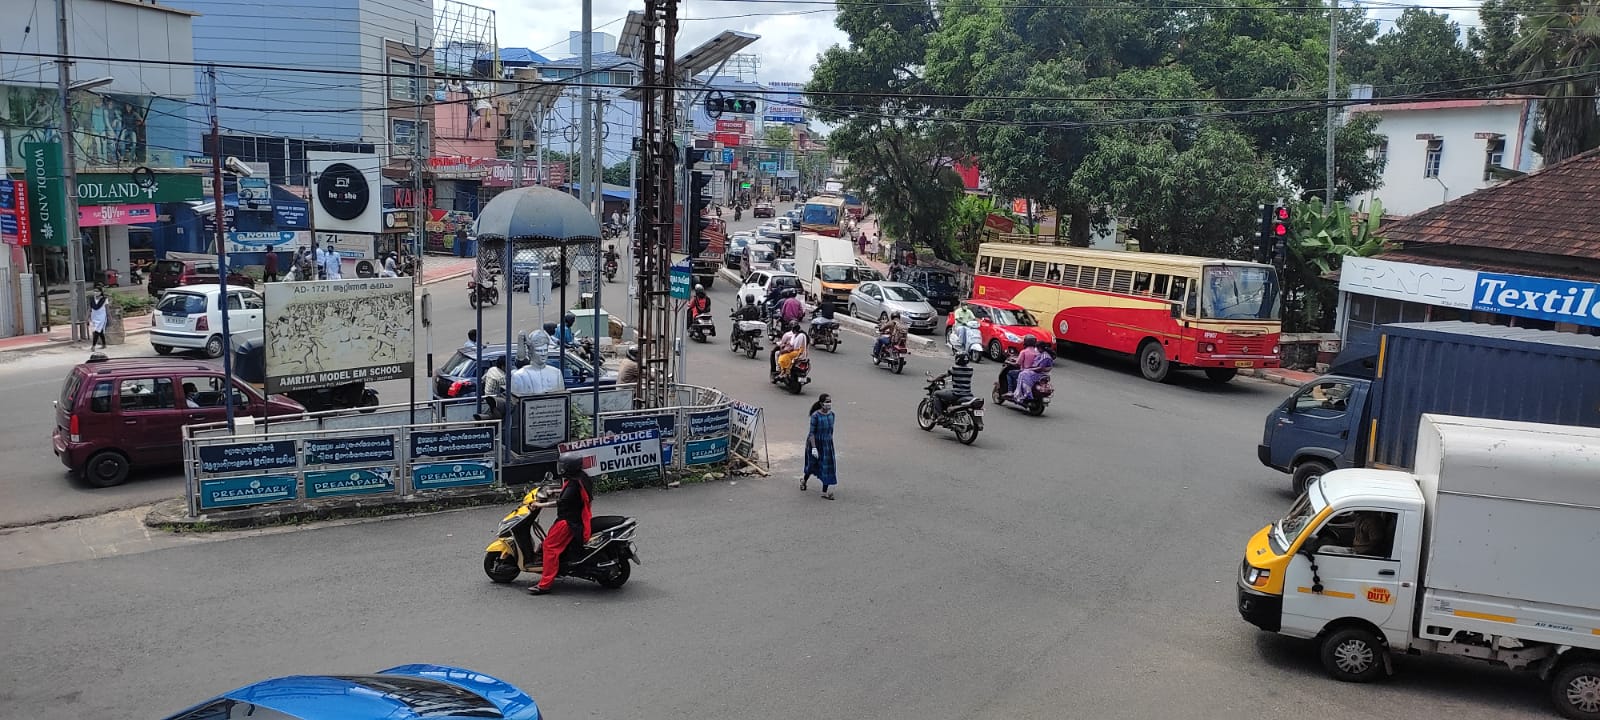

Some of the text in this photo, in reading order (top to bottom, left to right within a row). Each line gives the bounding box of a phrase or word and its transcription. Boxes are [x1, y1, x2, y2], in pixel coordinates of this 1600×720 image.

[34, 148, 49, 221] WOODLAND
[78, 184, 140, 198] ODLAND
[328, 190, 337, 199] he
[101, 206, 118, 219] 50%
[280, 375, 316, 386] AMRITA
[320, 372, 350, 382] MODEL
[353, 369, 366, 378] EM
[370, 366, 402, 376] SCHOOL
[737, 412, 749, 425] TAKE
[566, 437, 611, 450] TRAFFIC
[614, 430, 652, 443] POLICE
[614, 442, 641, 456] TAKE
[600, 453, 656, 471] DEVIATION
[421, 472, 457, 480] DREAM
[212, 485, 288, 498] DREAM PARK
[314, 481, 353, 490] DREAM
[1367, 591, 1390, 601] DUTY
